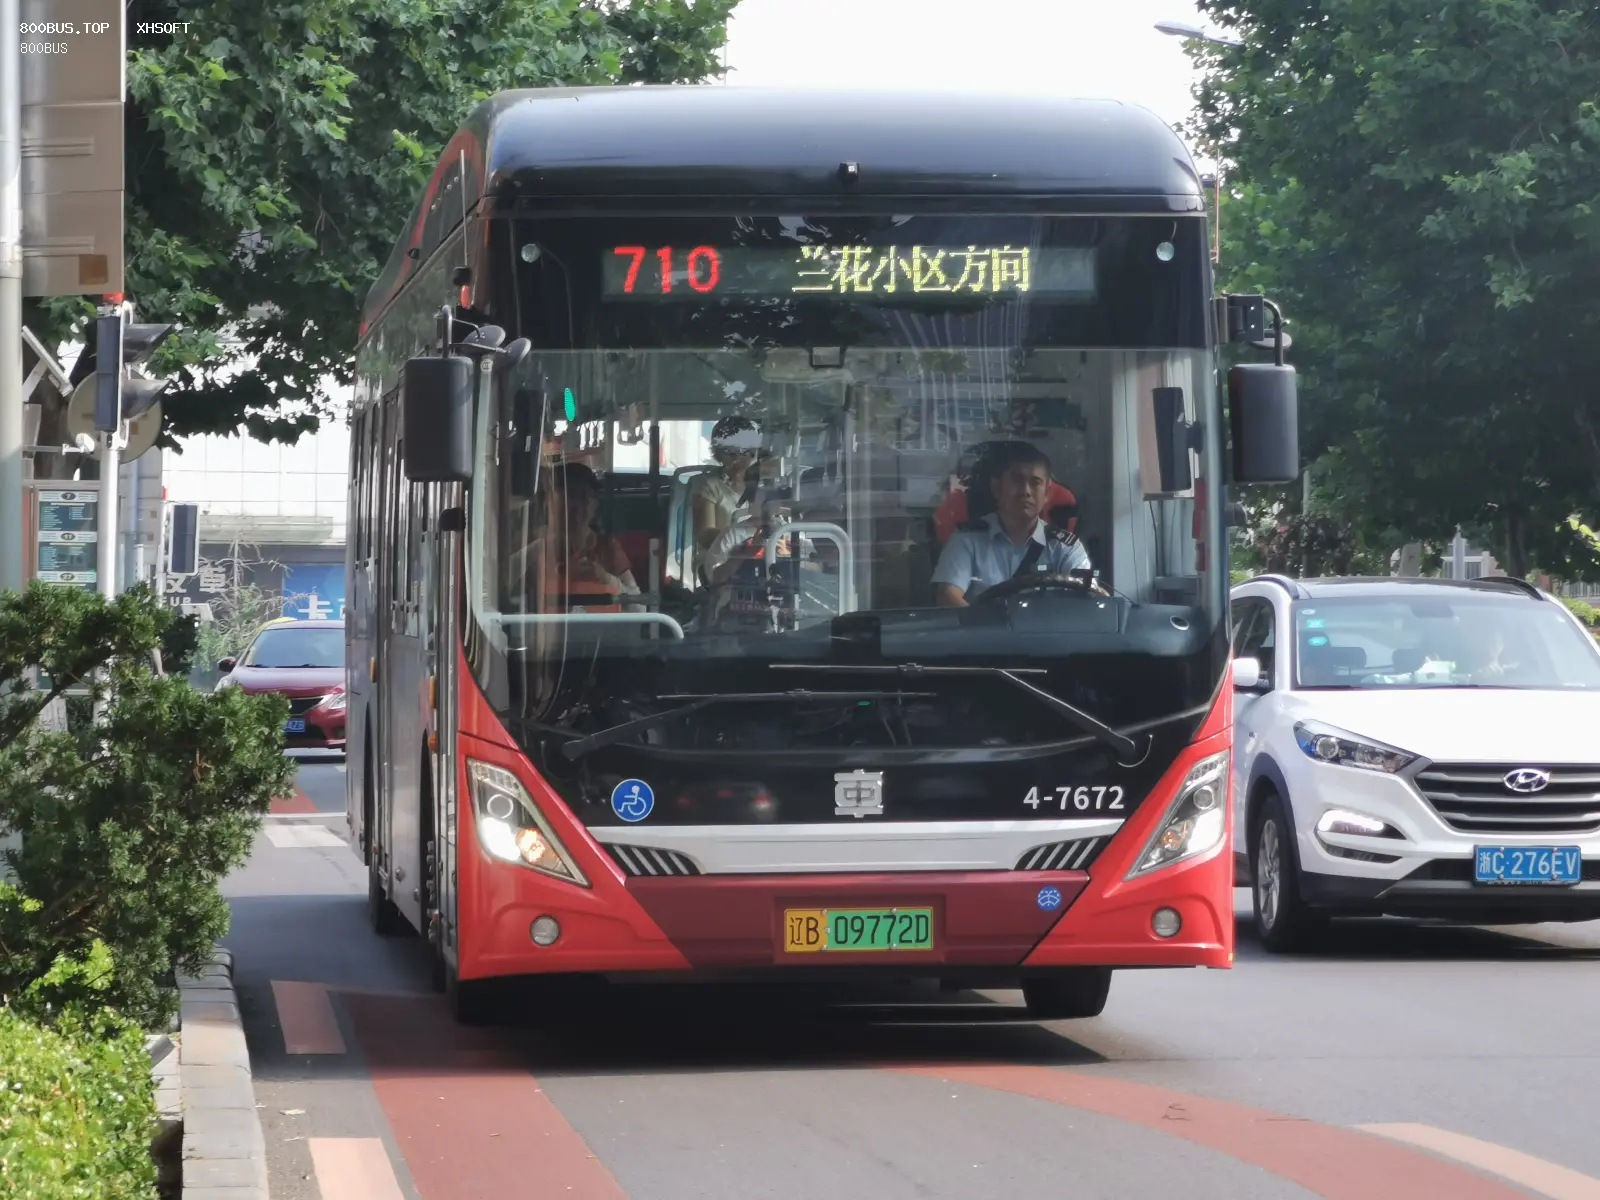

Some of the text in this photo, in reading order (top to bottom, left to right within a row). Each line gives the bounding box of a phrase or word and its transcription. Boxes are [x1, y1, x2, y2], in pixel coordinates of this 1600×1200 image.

[613, 245, 720, 293] 710
[791, 245, 1030, 293] 兰花小区方向
[1022, 785, 1125, 810] 4-7672
